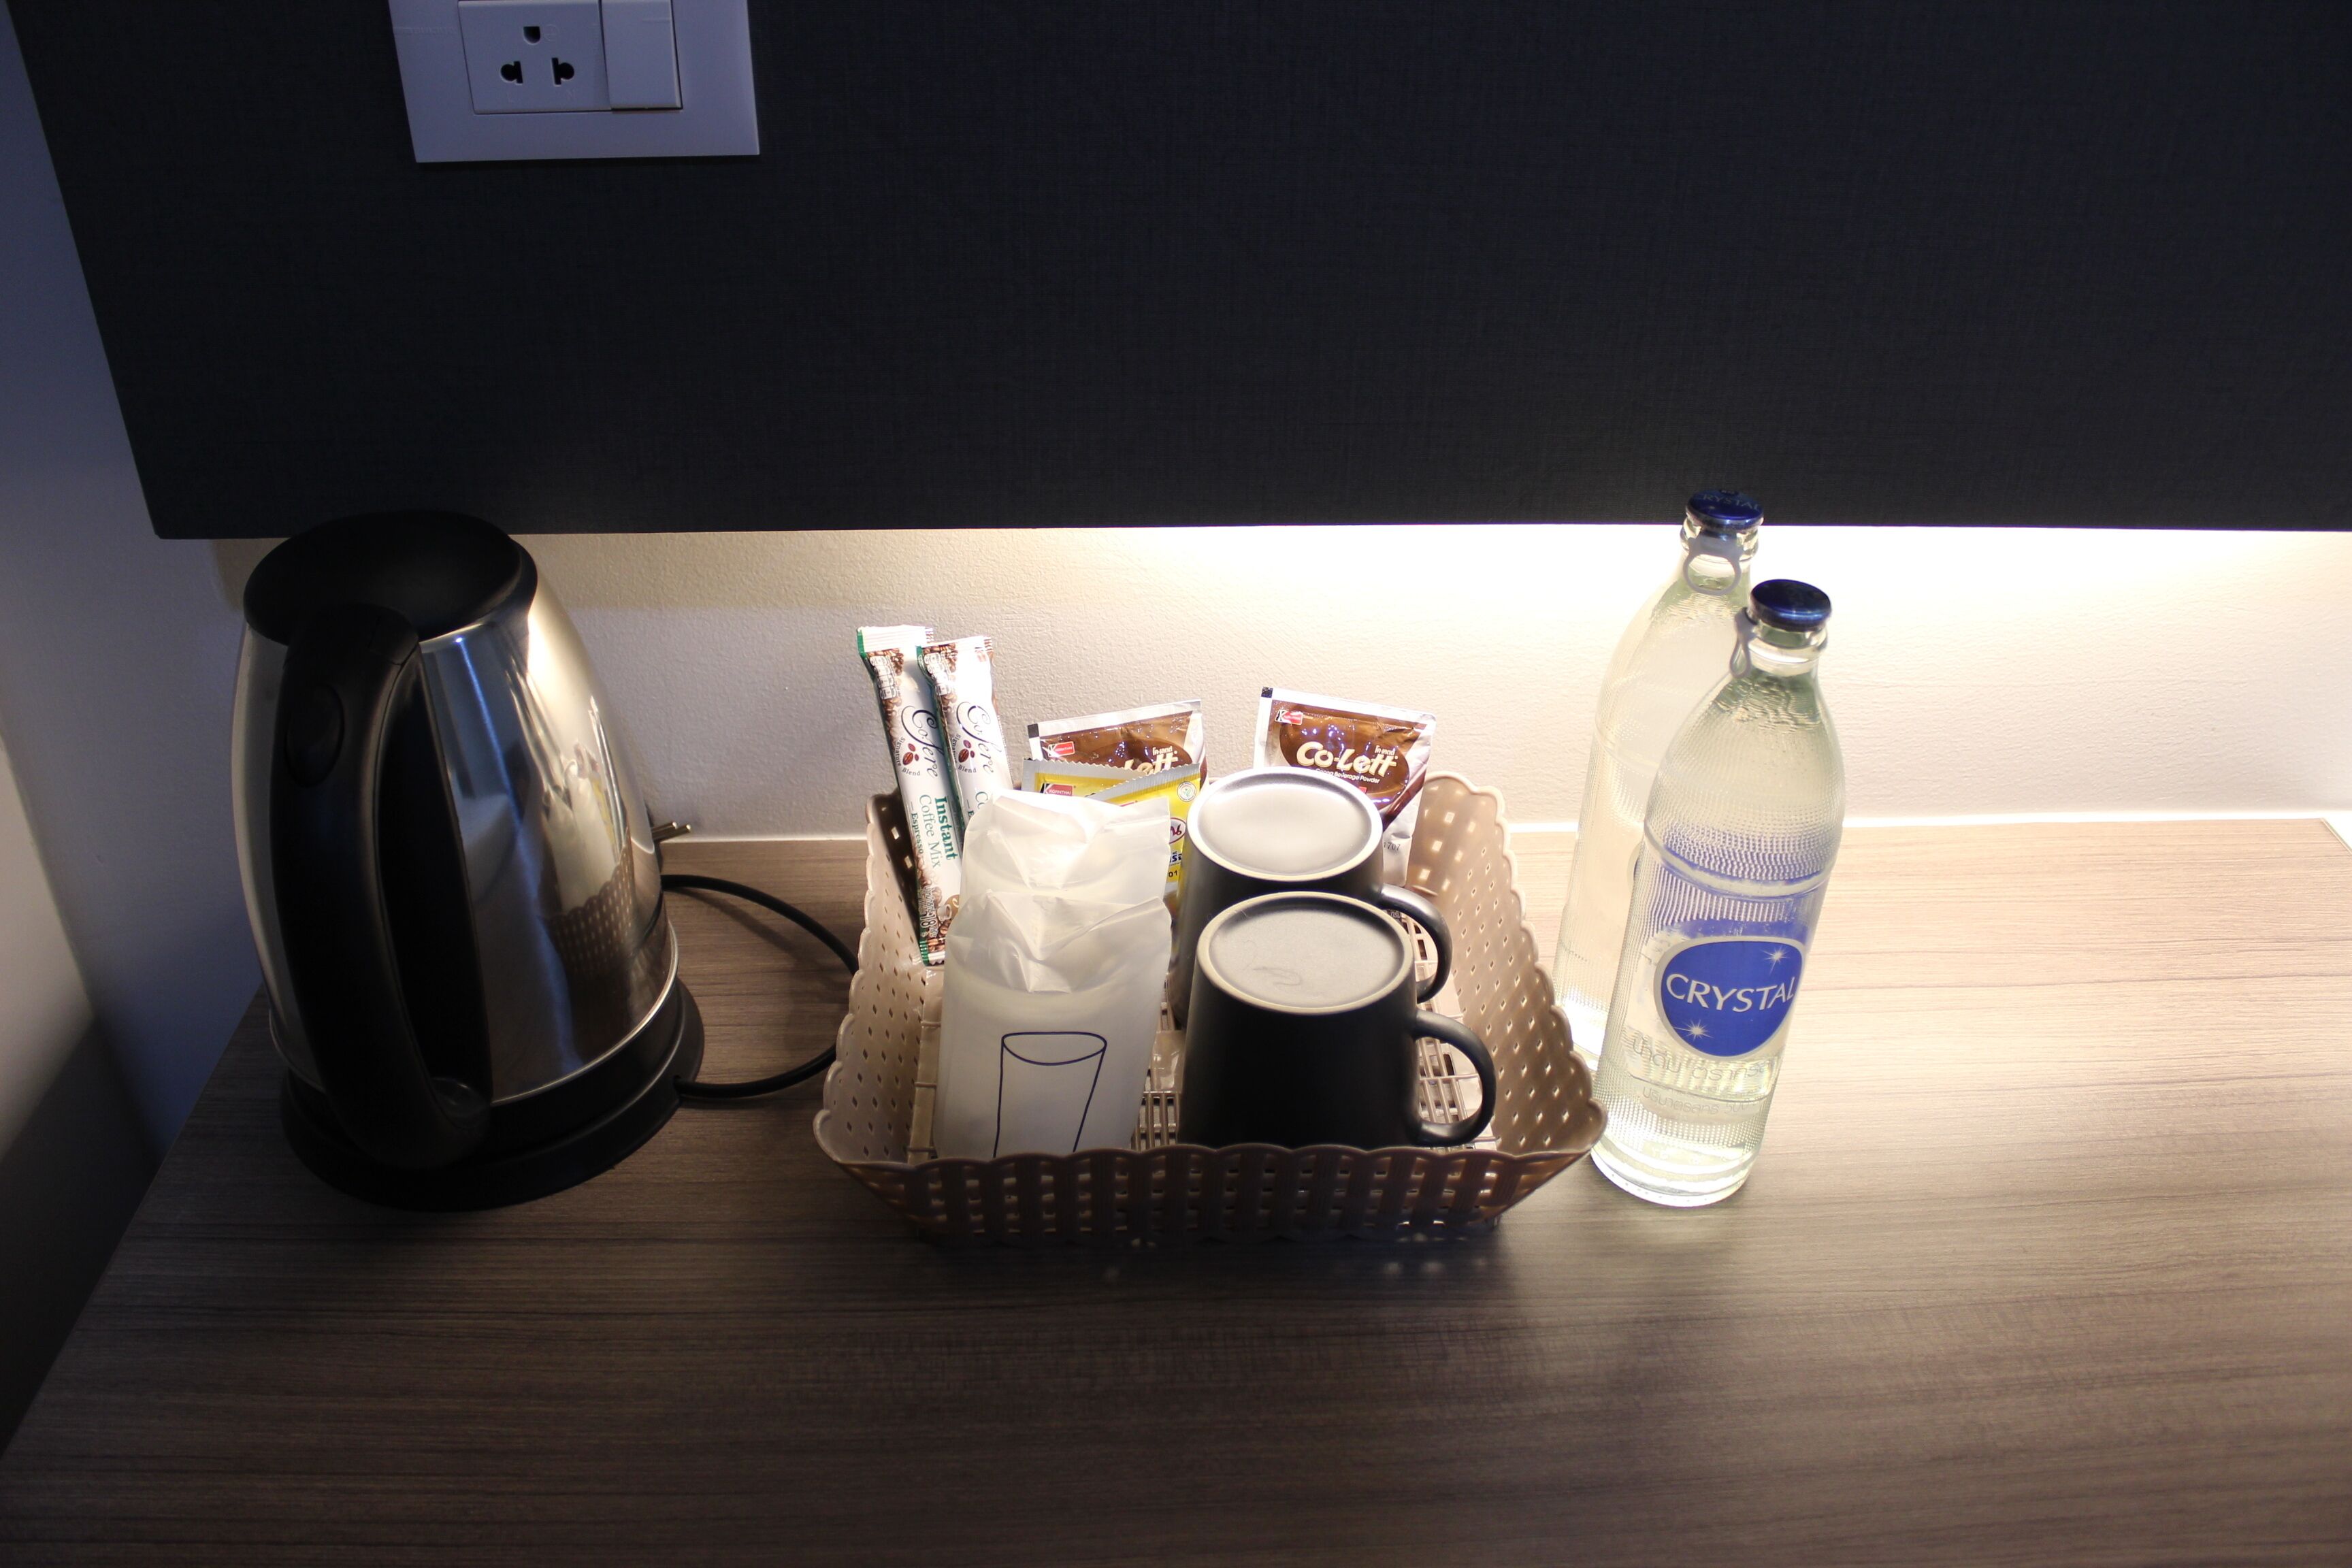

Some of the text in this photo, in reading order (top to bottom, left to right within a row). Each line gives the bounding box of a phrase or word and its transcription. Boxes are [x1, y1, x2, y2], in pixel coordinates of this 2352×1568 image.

[1701, 493, 1761, 512] RYSTAL
[895, 736, 921, 776] Signature Blend
[958, 764, 977, 774] Blend
[1334, 770, 1360, 781] Beverage
[1360, 774, 1381, 784] Powder
[911, 813, 924, 855] Espresso
[919, 794, 943, 868] Coffee Mix
[934, 796, 958, 860] Instant
[920, 913, 937, 928] 18
[1666, 973, 1795, 1013] CRYSTAL
